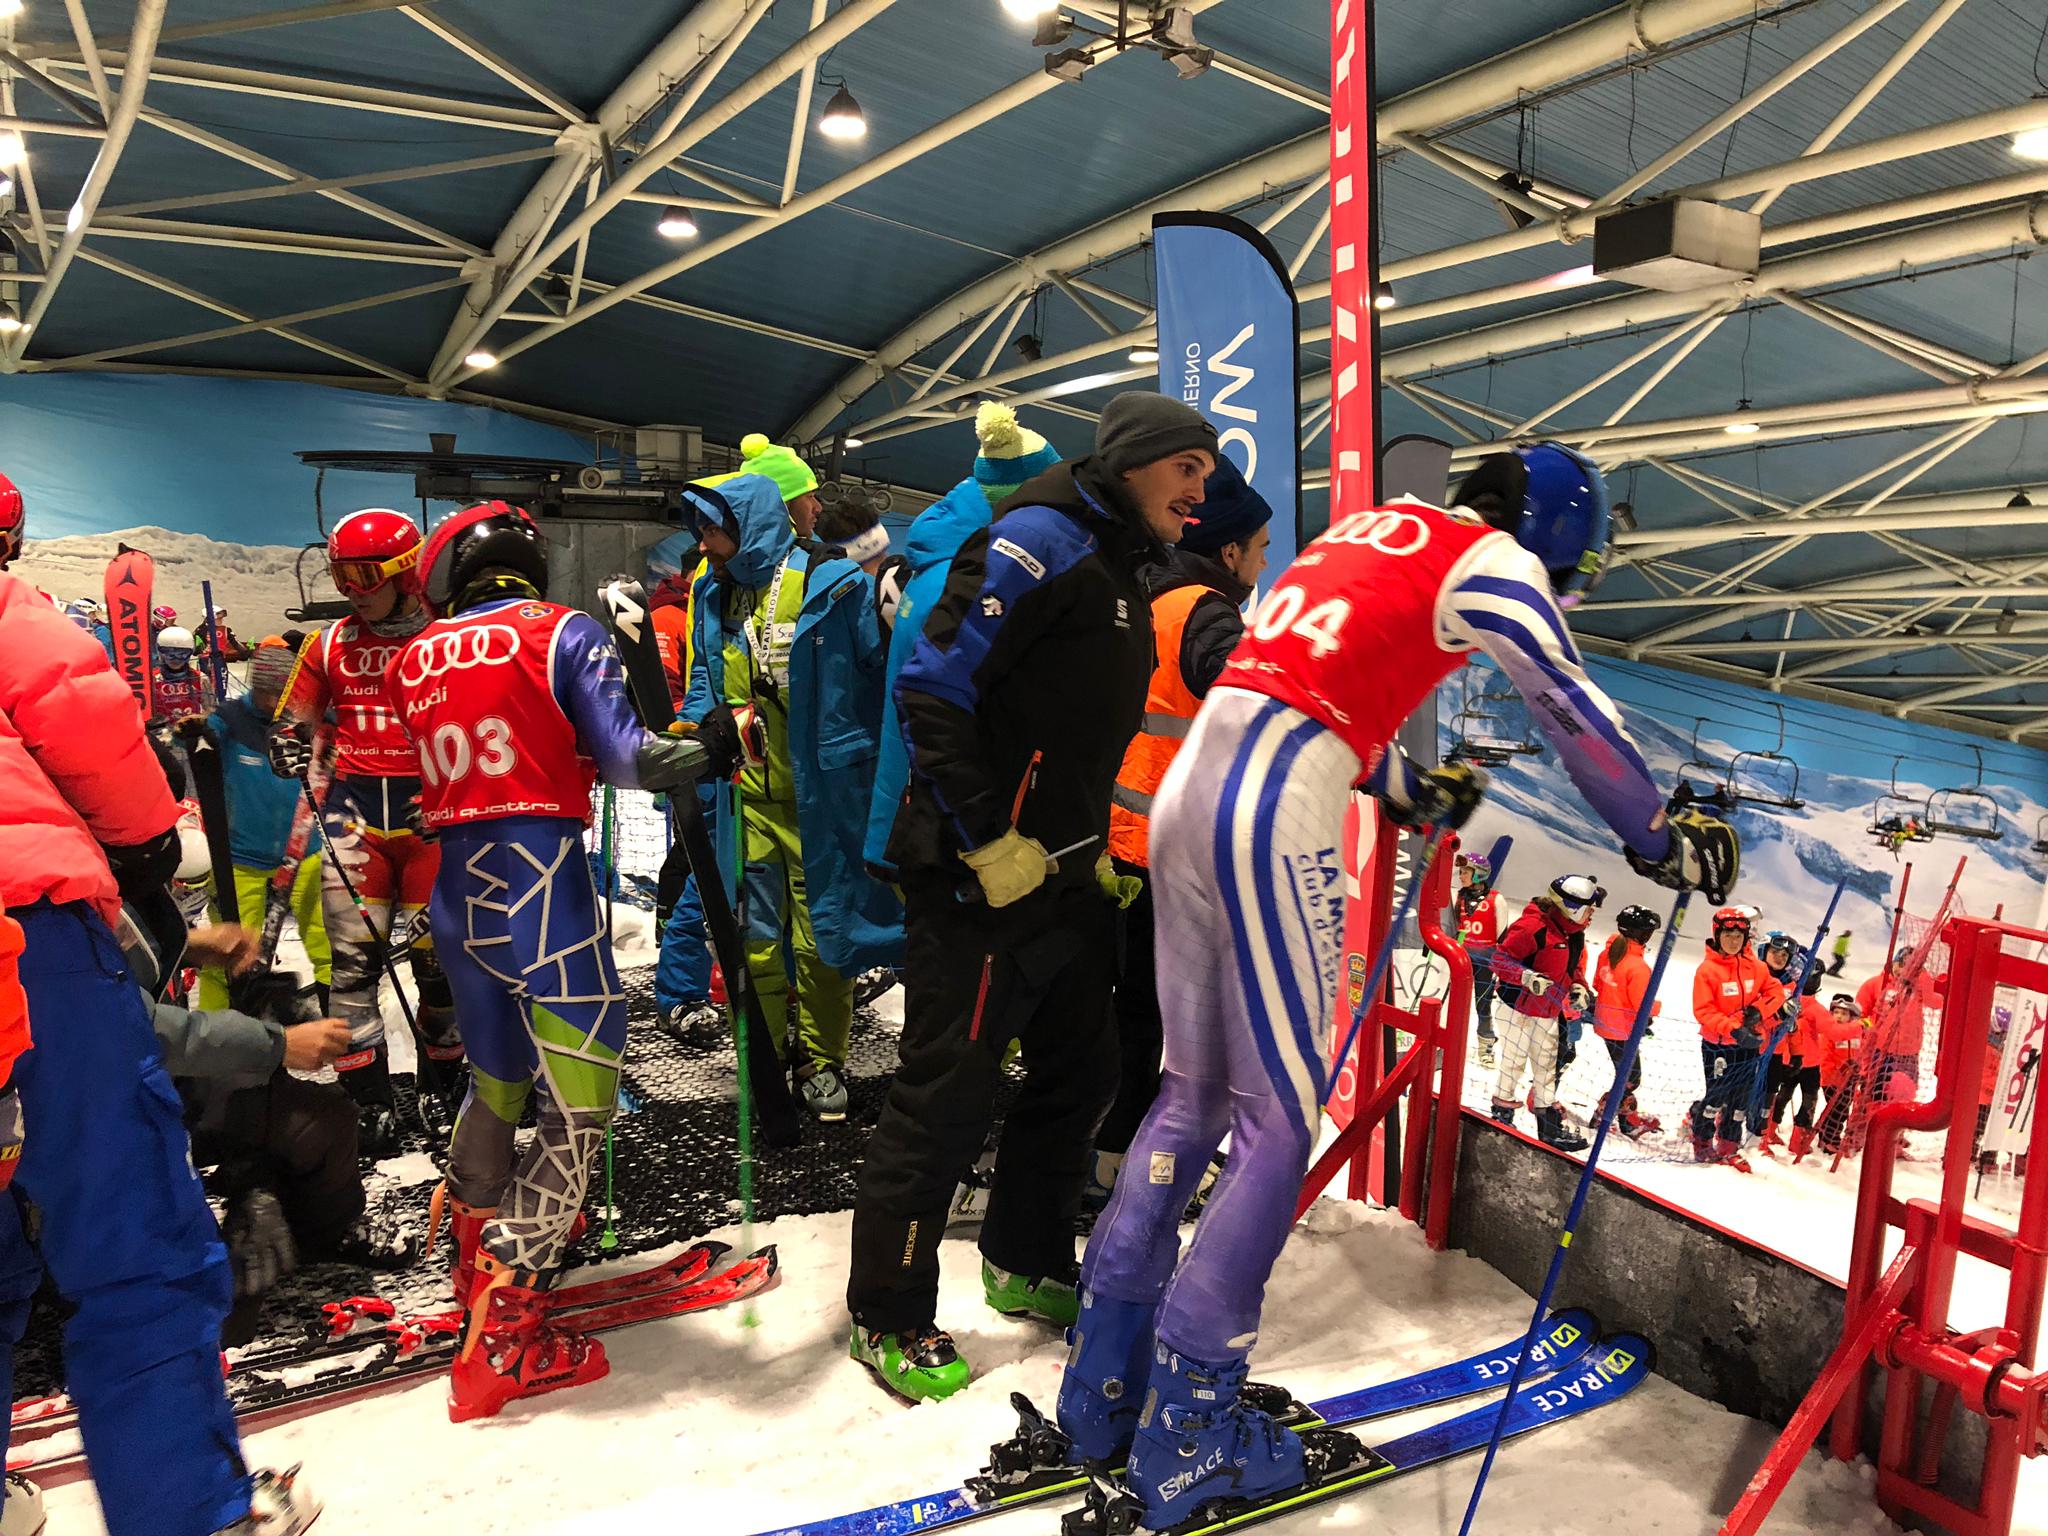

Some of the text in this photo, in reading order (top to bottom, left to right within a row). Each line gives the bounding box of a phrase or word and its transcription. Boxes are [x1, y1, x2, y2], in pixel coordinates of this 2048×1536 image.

[998, 543, 1040, 574] HEAD
[118, 597, 147, 711] ATOMIC
[343, 684, 378, 695] Audi
[406, 686, 447, 718] Audi
[417, 716, 517, 787] 103
[460, 801, 560, 818] quattro
[1297, 854, 1325, 908] club
[1315, 847, 1339, 888] LA
[1463, 921, 1483, 935] 30
[902, 1220, 918, 1267] DESCENTE
[525, 1368, 578, 1388] ATOMIC
